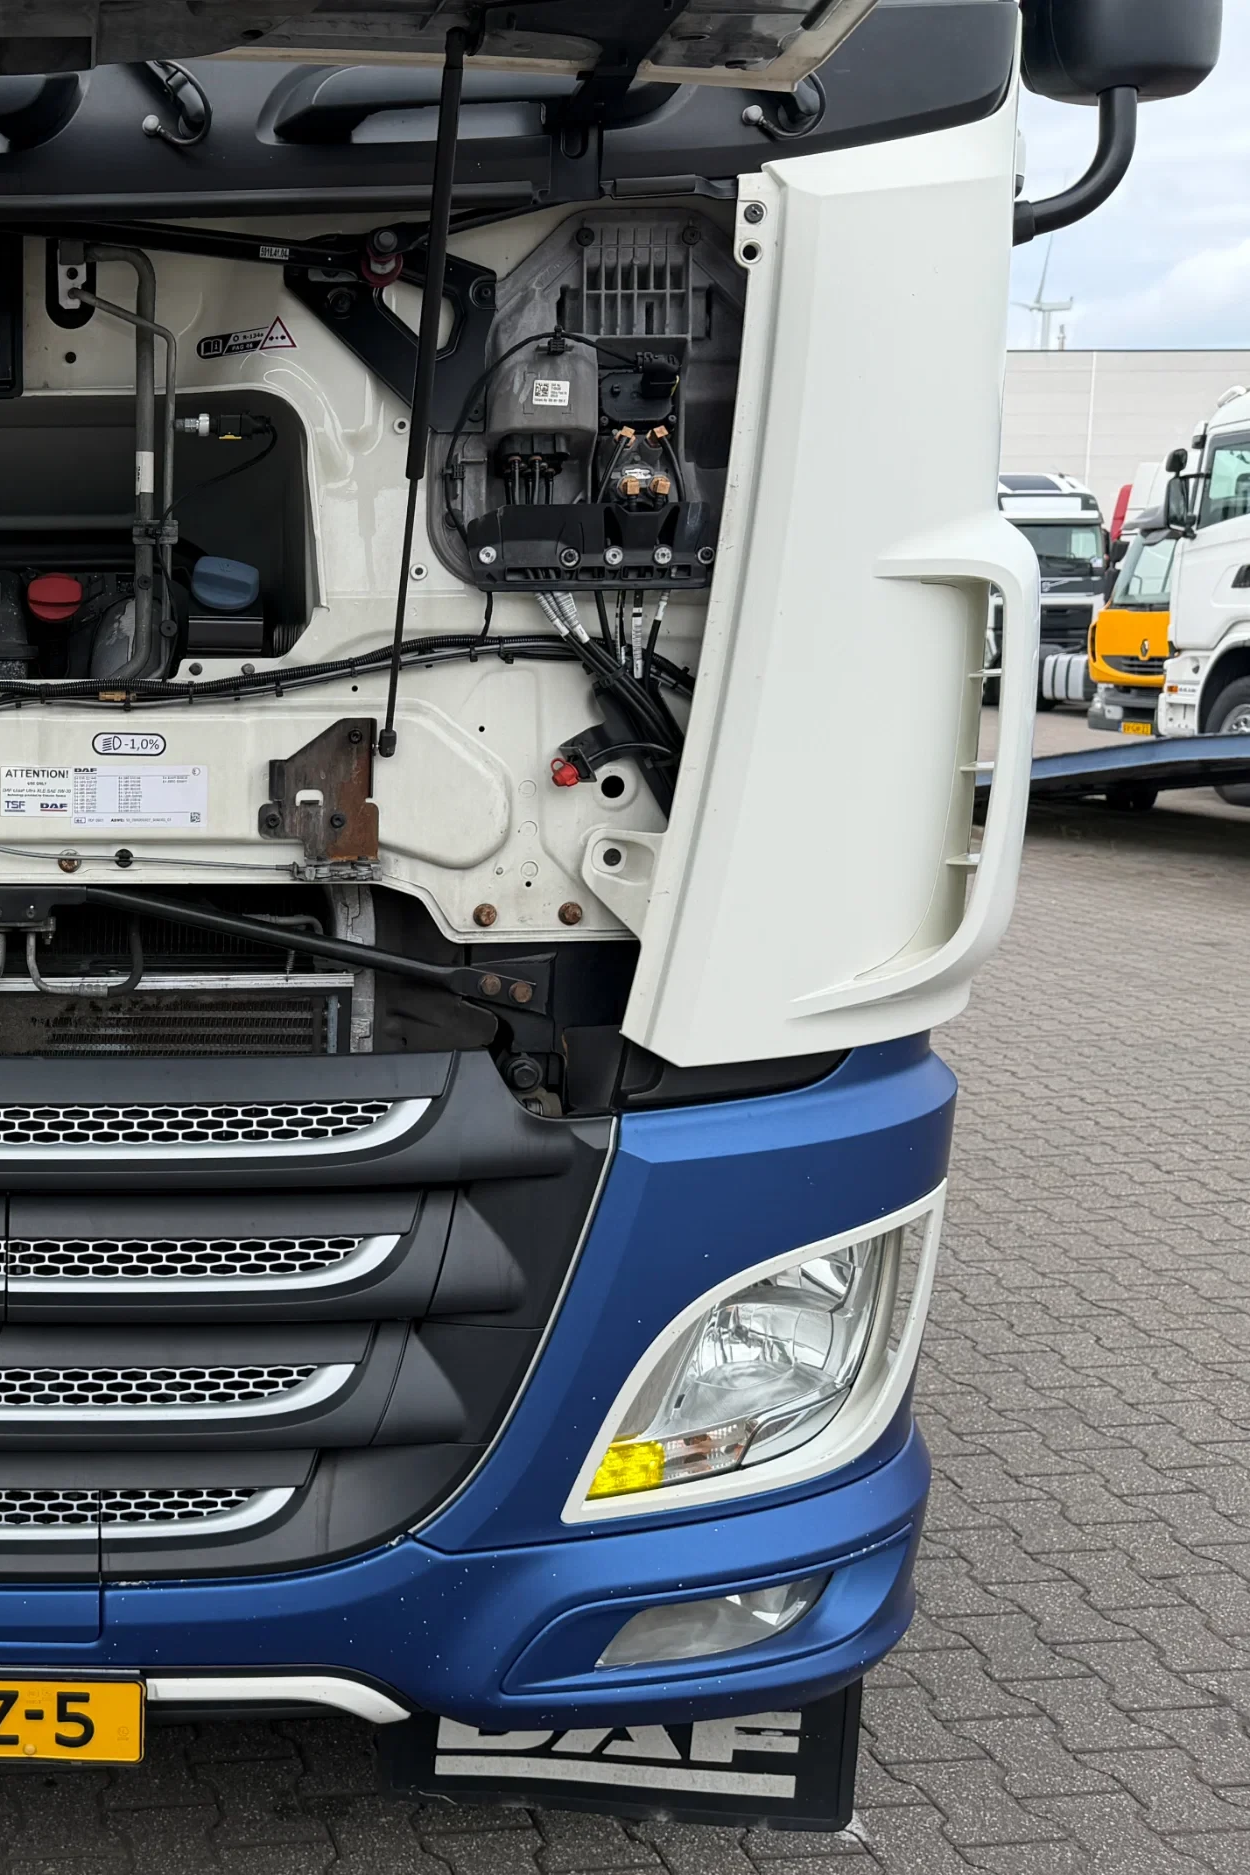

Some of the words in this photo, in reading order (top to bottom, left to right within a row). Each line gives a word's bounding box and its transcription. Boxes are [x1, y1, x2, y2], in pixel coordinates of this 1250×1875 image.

[123, 738, 160, 751] -1,0%
[5, 769, 69, 779] ATTENTION!
[4, 800, 26, 809] TSF
